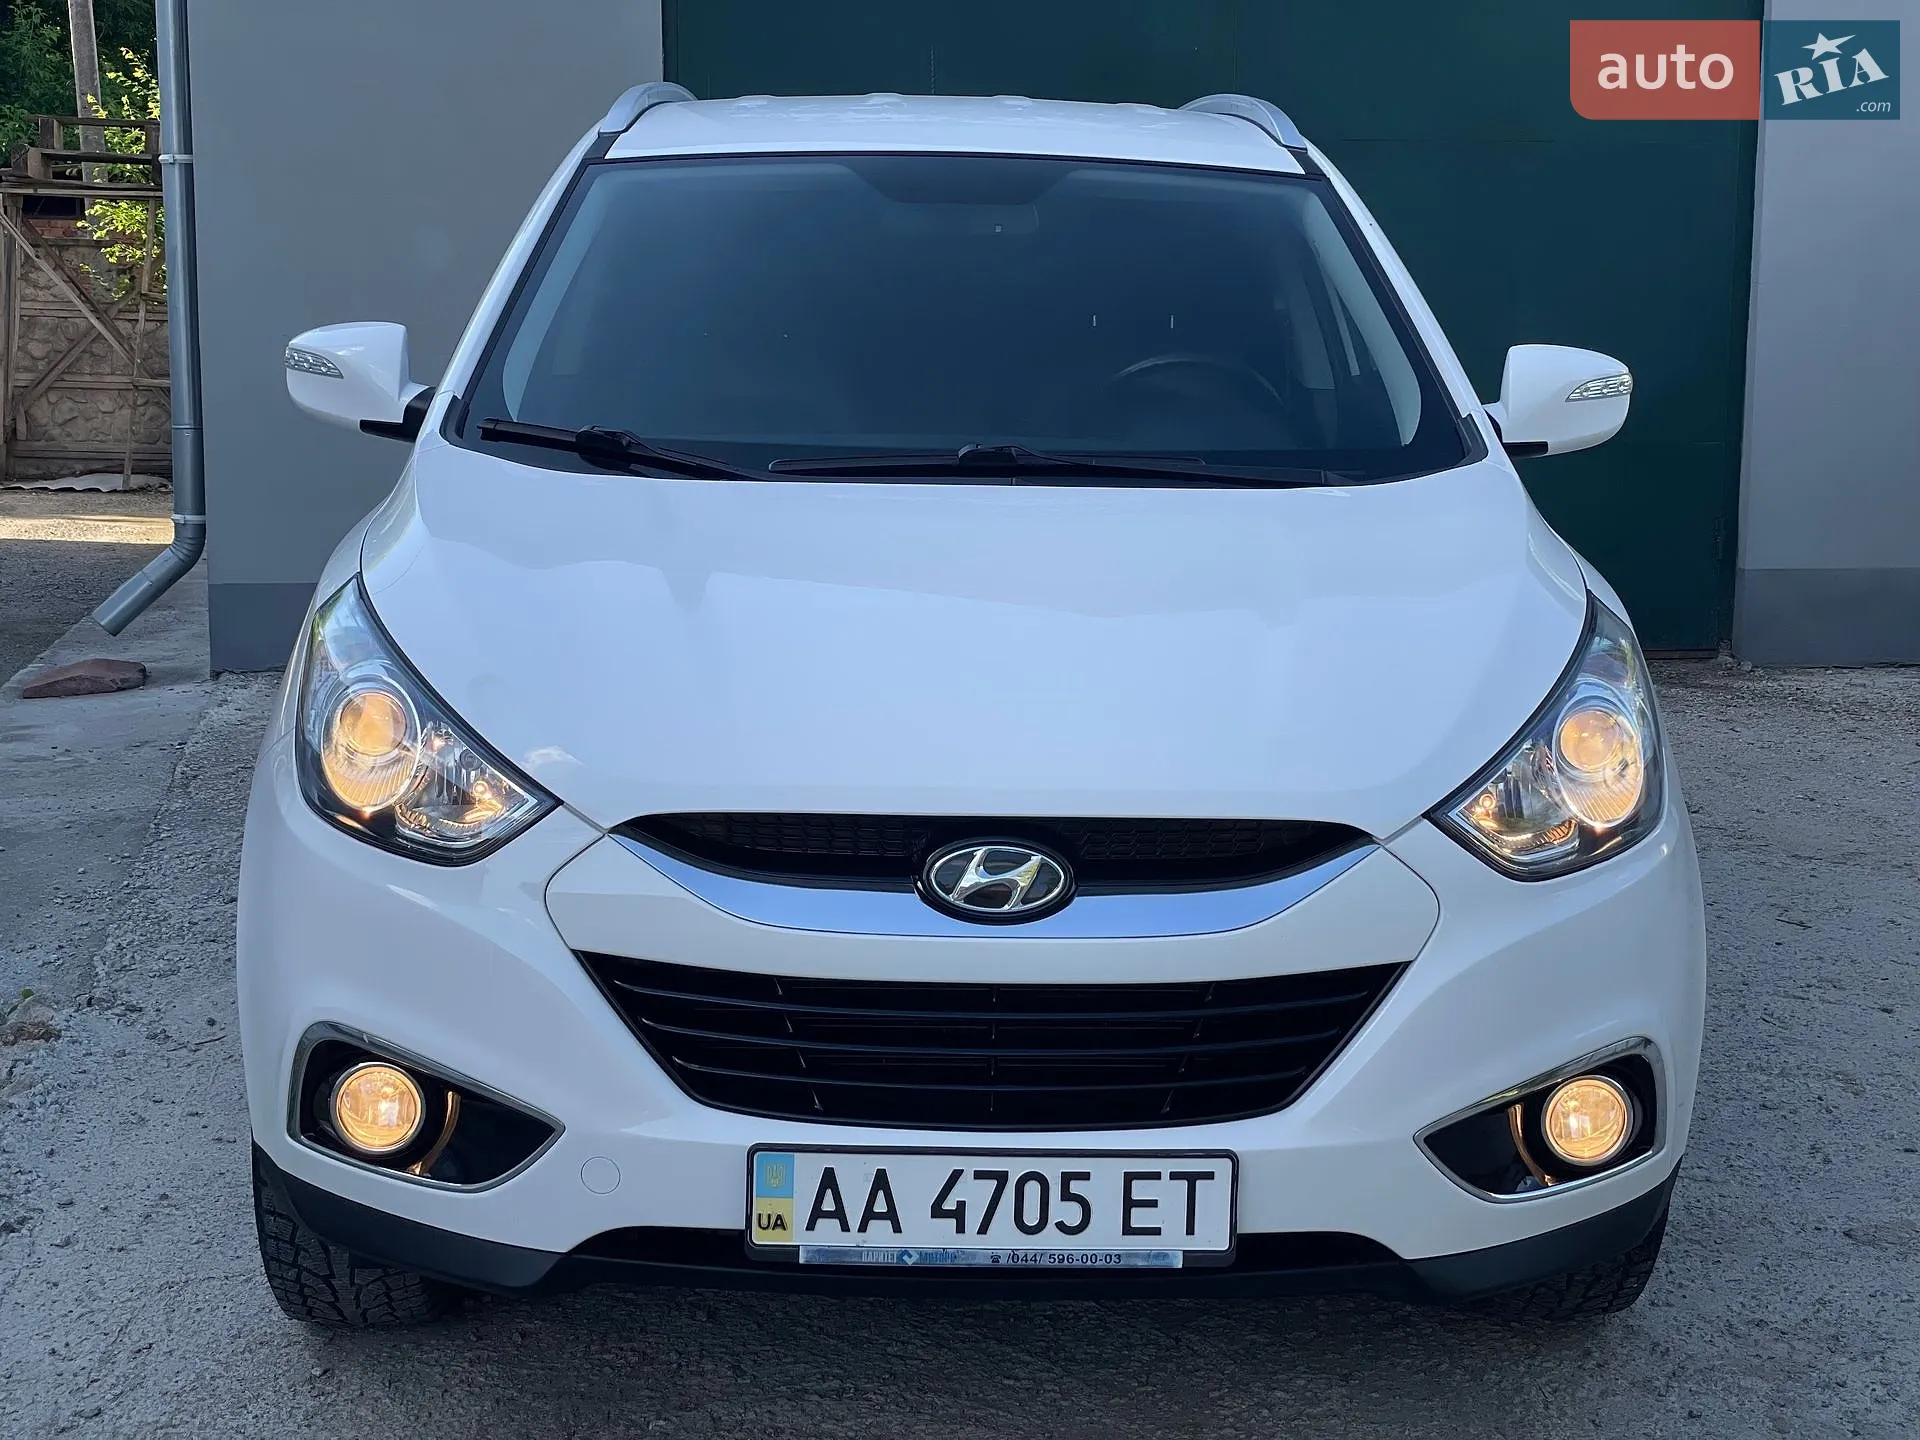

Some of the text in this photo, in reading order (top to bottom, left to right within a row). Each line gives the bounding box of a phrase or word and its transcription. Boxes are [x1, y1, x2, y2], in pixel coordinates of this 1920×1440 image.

[805, 1166, 1215, 1237] AA 4705 ET
[758, 1212, 787, 1232] UA
[1048, 1252, 1122, 1265] 596-00-03
